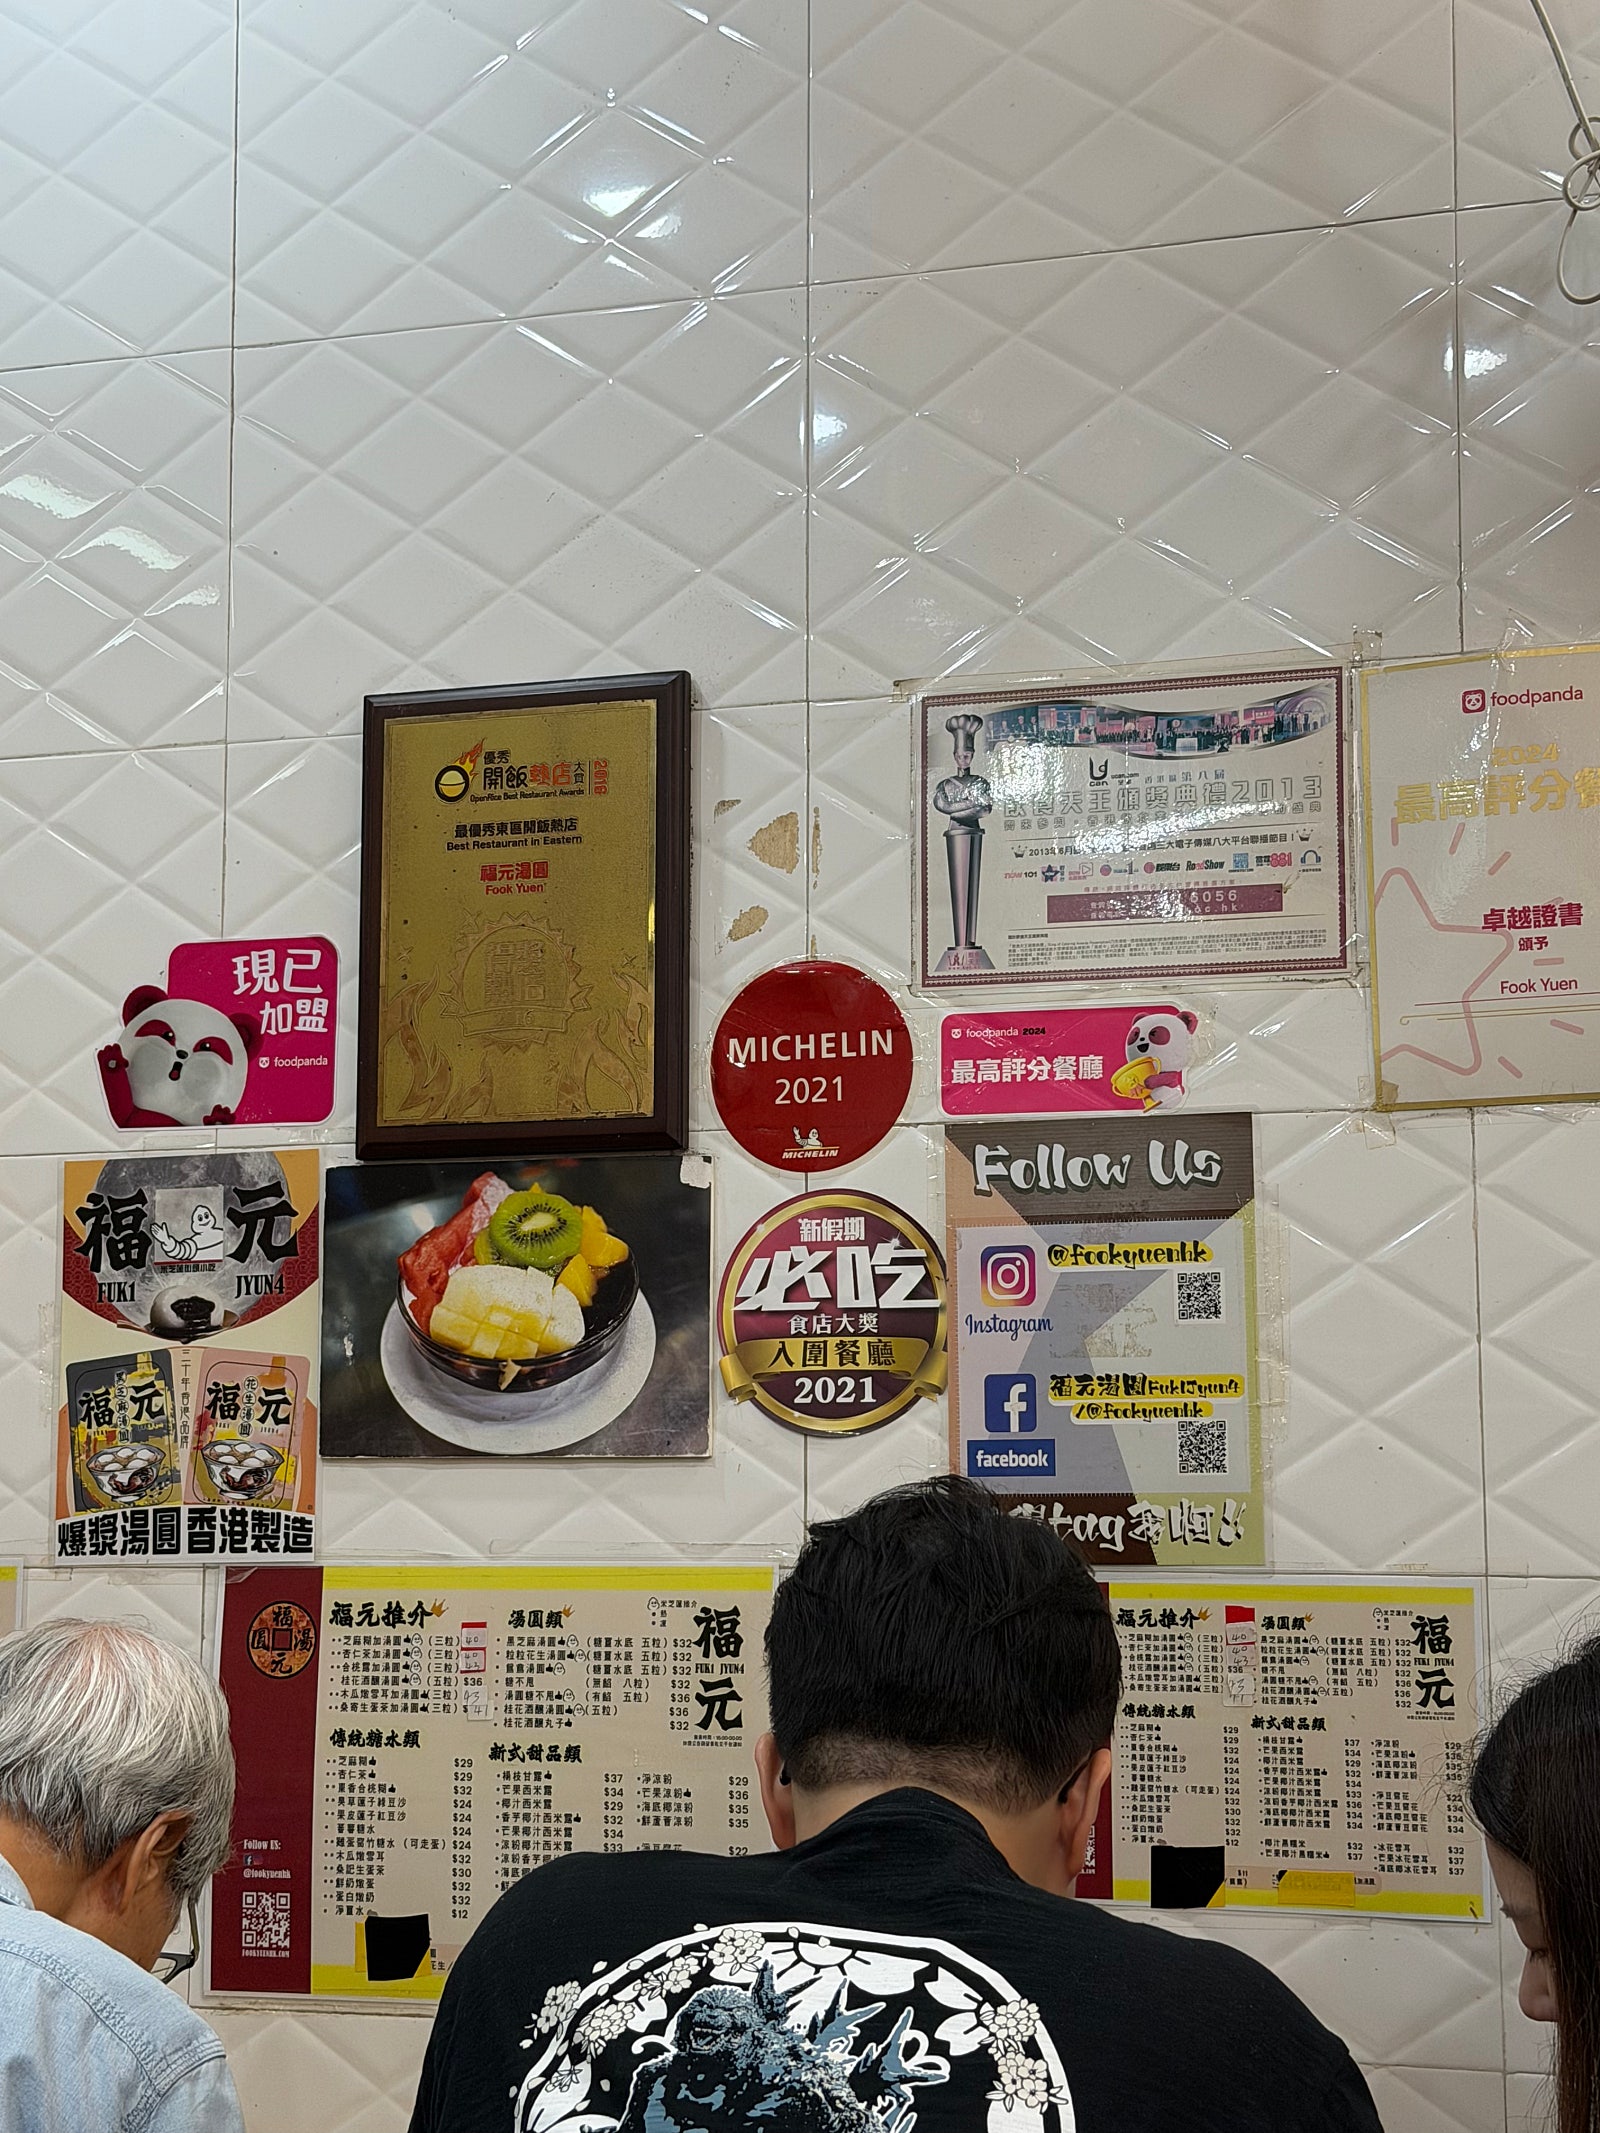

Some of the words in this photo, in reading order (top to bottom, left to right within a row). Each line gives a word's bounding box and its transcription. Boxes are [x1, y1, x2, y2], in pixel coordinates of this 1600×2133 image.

[1491, 686, 1584, 707] foodpanda
[484, 750, 510, 764] 優秀
[1491, 743, 1560, 766] 2024
[483, 762, 572, 791] 開飯熱店
[470, 794, 502, 803] OpenRice
[503, 792, 518, 800] Best
[520, 790, 558, 799] Restaurant
[559, 788, 584, 796] Awards
[455, 818, 577, 838] 最優秀東區開飯熱店
[447, 842, 469, 851] Best
[473, 839, 528, 849] Restaurant
[543, 836, 582, 845] Eastern
[480, 861, 549, 882] 福元湯圓
[1186, 860, 1225, 872] RoadShow
[485, 883, 513, 895] Fook
[516, 882, 543, 894] Yuen
[1482, 902, 1583, 932] 卓越證書
[1519, 936, 1548, 951] 頒予
[232, 949, 323, 995] 現已
[1501, 979, 1537, 994] Fook
[1540, 977, 1577, 991] Yuen
[260, 998, 329, 1035] 加盟
[966, 1027, 1018, 1039] foodpanda
[1022, 1027, 1046, 1035] 2024
[729, 1029, 893, 1063] MICHELIN
[274, 1056, 328, 1070] foodpanda
[951, 1055, 1103, 1084] 最高評分餐廳
[775, 1076, 842, 1105] 2021
[782, 1150, 838, 1159] MICHELIN
[975, 1142, 1131, 1197] Follow
[1148, 1139, 1222, 1189] Us
[74, 1188, 152, 1273] 福
[226, 1181, 299, 1263] 元
[799, 1217, 865, 1242] 新假期
[1049, 1240, 1207, 1269] @fookyuenhk
[731, 1243, 942, 1311] 必吃
[97, 1281, 135, 1303] FUK1
[235, 1275, 285, 1298] JYUN4
[788, 1313, 878, 1334] 食店大獎
[965, 1313, 1054, 1341] Instagram
[768, 1339, 896, 1368] 入圍餐廳
[794, 1377, 877, 1404] 2021
[79, 1389, 115, 1429] 福
[129, 1382, 165, 1421] 元
[205, 1382, 241, 1420] 福
[257, 1387, 293, 1424] 元
[976, 1449, 1048, 1468] facebook
[58, 1507, 313, 1557] 爆漿湯圓香港製造
[272, 1606, 293, 1627] 福
[329, 1600, 434, 1628] 福元推介
[508, 1610, 563, 1628] 湯圓類
[1116, 1608, 1200, 1629] 福元推介
[1261, 1616, 1306, 1630] 湯圓類
[251, 1628, 270, 1651] 圓
[294, 1628, 313, 1651] 湯
[692, 1605, 744, 1659] 福
[1410, 1615, 1452, 1654] 福
[343, 1636, 401, 1646] 芝麻糊加湯圓
[507, 1636, 556, 1647] 黑芝麻湯圓
[673, 1639, 692, 1648] $32
[343, 1650, 400, 1659] 杏仁茶加湯圓
[506, 1650, 566, 1661] 粒粒花生湯圓
[673, 1652, 692, 1662] $32
[271, 1652, 292, 1674] 元
[672, 1666, 691, 1675] $32
[695, 1663, 714, 1674] FUK1
[720, 1663, 744, 1675] JYUN4
[464, 1677, 483, 1687] $36
[505, 1677, 534, 1687] 糖不甩
[671, 1680, 690, 1689] $32
[1415, 1668, 1455, 1708] 元
[505, 1690, 554, 1701] 湯圓糖不甩
[671, 1693, 690, 1703] $36
[694, 1677, 743, 1731] 元
[669, 1707, 689, 1716] $36
[1122, 1704, 1196, 1718] 傳統糖水類
[670, 1721, 689, 1730] $32
[1251, 1715, 1326, 1731] 新式甜品類
[330, 1728, 420, 1748] 傳統糖水類
[489, 1742, 582, 1763] 新式甜品類
[338, 1756, 367, 1766] 芝麻糊
[454, 1758, 473, 1768] $29
[338, 1770, 367, 1780] 杏仁茶
[454, 1772, 472, 1782] $29
[502, 1771, 542, 1782] 楊枝甘露
[604, 1774, 623, 1783] $37
[729, 1776, 748, 1786] $29
[453, 1786, 472, 1795] $32
[502, 1785, 552, 1796] 芒果西米露
[604, 1788, 623, 1797] $34
[729, 1790, 748, 1800] $36
[453, 1799, 472, 1809] $24
[502, 1799, 552, 1809] 椰汁西米露
[604, 1802, 623, 1811] $29
[729, 1804, 748, 1814] $35
[453, 1813, 471, 1822] $24
[502, 1812, 572, 1824] 香芋椰汁西米露
[604, 1816, 623, 1825] $32
[729, 1818, 748, 1828] $35
[1225, 1818, 1240, 1826] $32
[452, 1827, 471, 1836] $24
[502, 1826, 572, 1838] 芒果椰汁西米露
[604, 1829, 623, 1838] $34
[244, 1839, 268, 1850] Follow
[452, 1840, 471, 1850] $24
[336, 1851, 385, 1862] 木瓜燉雪耳
[452, 1854, 471, 1864] $32
[452, 1868, 471, 1878] $30
[336, 1878, 375, 1889] 鮮奶燉蛋
[452, 1882, 470, 1891] $32
[335, 1891, 375, 1903] 蛋白燉奶
[452, 1896, 470, 1905] $32
[451, 1909, 468, 1919] $12
